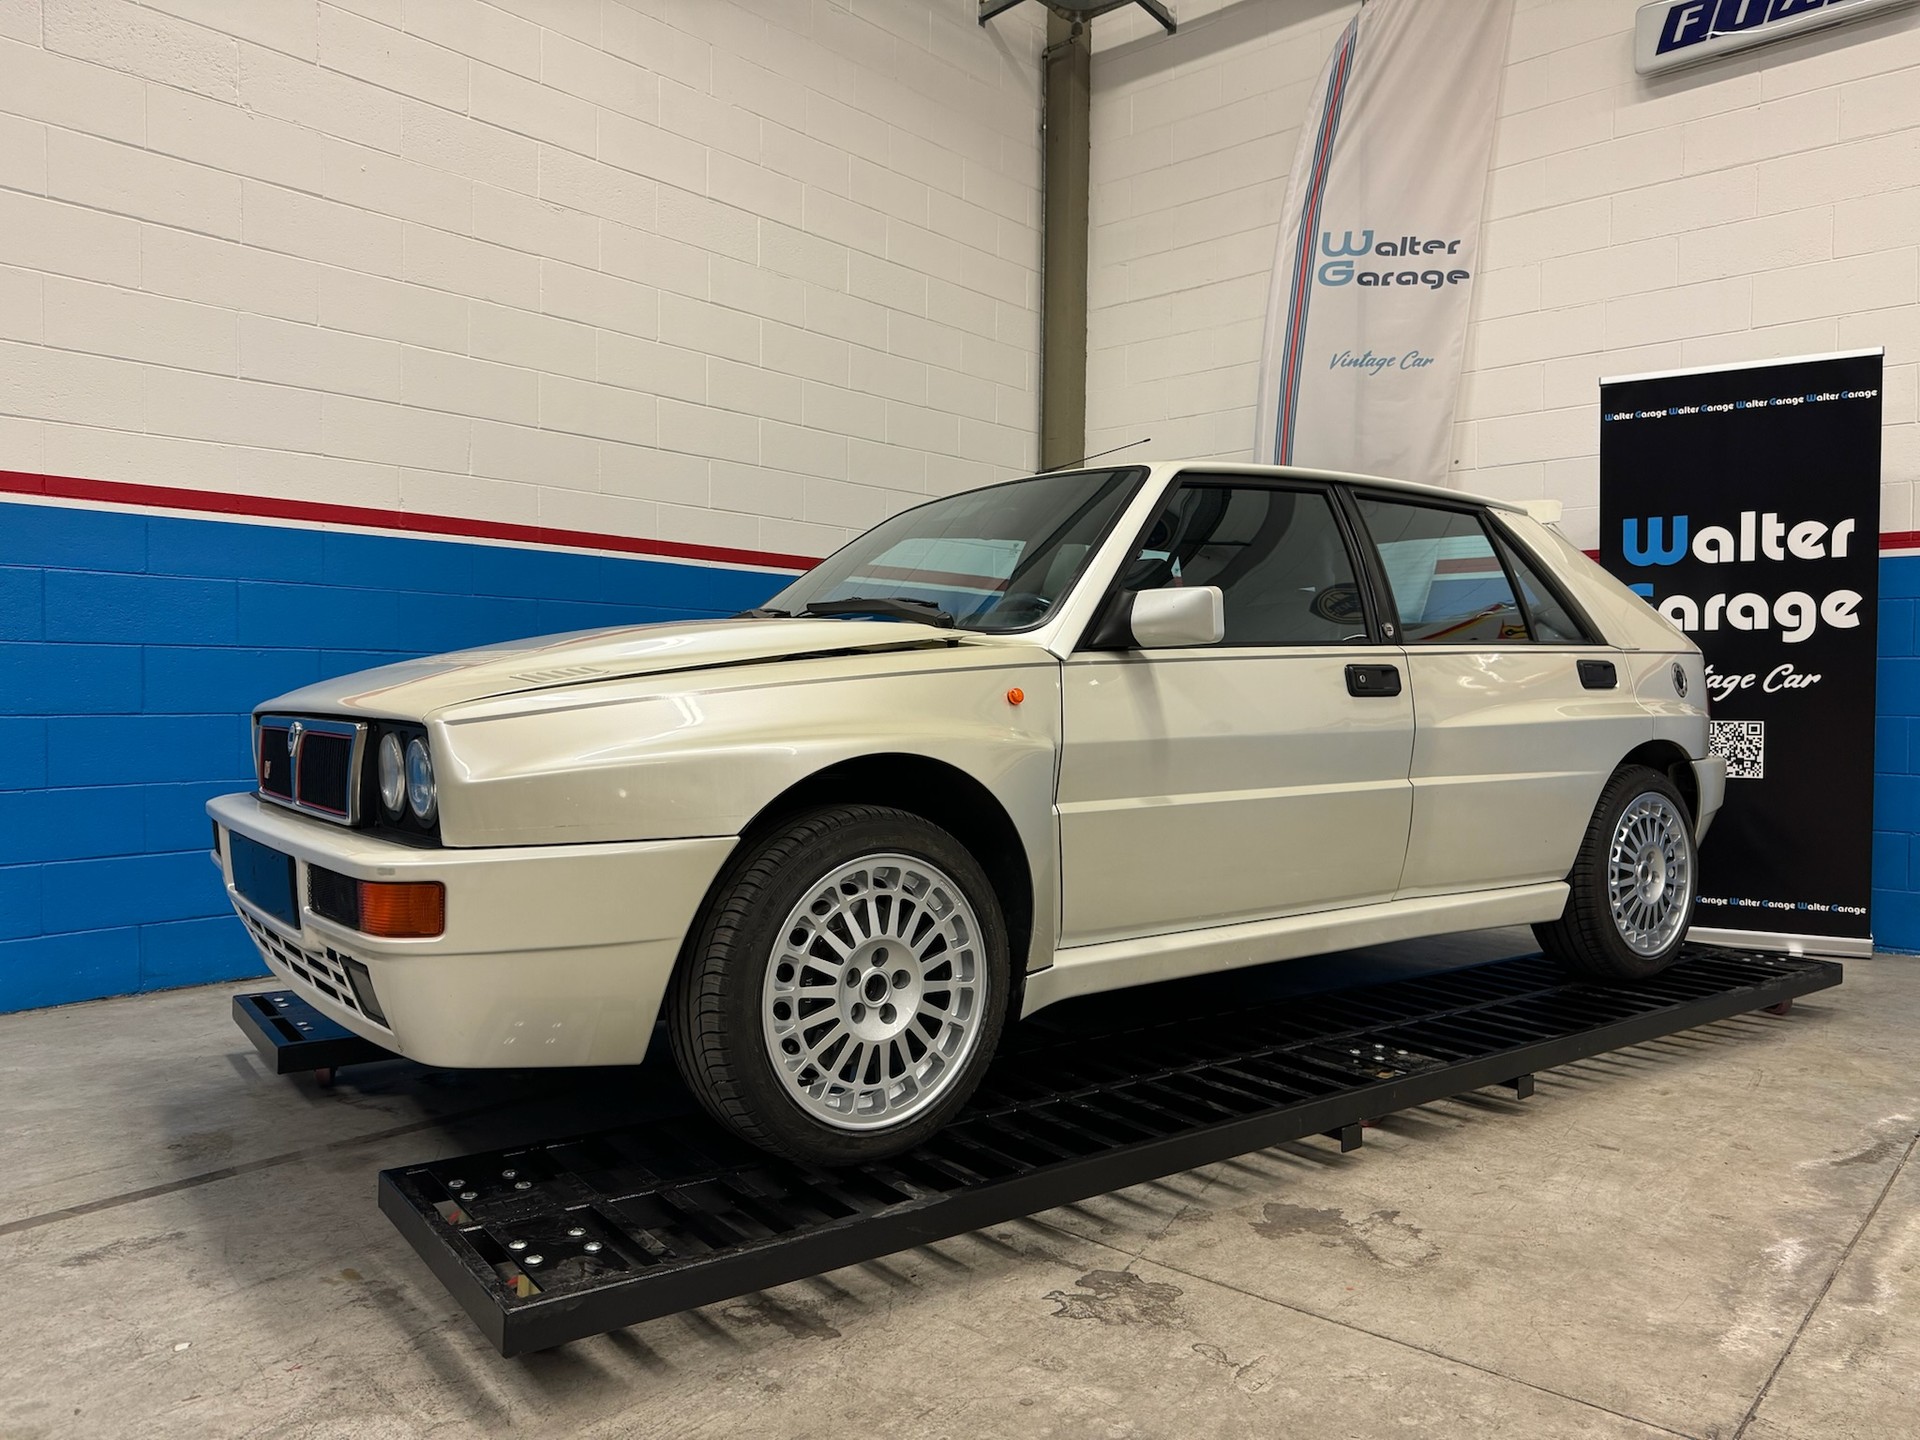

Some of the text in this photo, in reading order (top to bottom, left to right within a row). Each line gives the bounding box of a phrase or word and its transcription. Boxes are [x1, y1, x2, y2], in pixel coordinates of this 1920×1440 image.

[1321, 229, 1461, 258] Walter
[1317, 260, 1470, 290] Garage
[1329, 350, 1435, 376] Vintage Car
[1604, 389, 1878, 422] Walter Garage Walter Garage Walter Garage Walter Garage
[1622, 510, 1856, 567] Walter
[1762, 663, 1822, 694] Car
[1695, 895, 1867, 915] Garage Walter Garage Walter Garage
